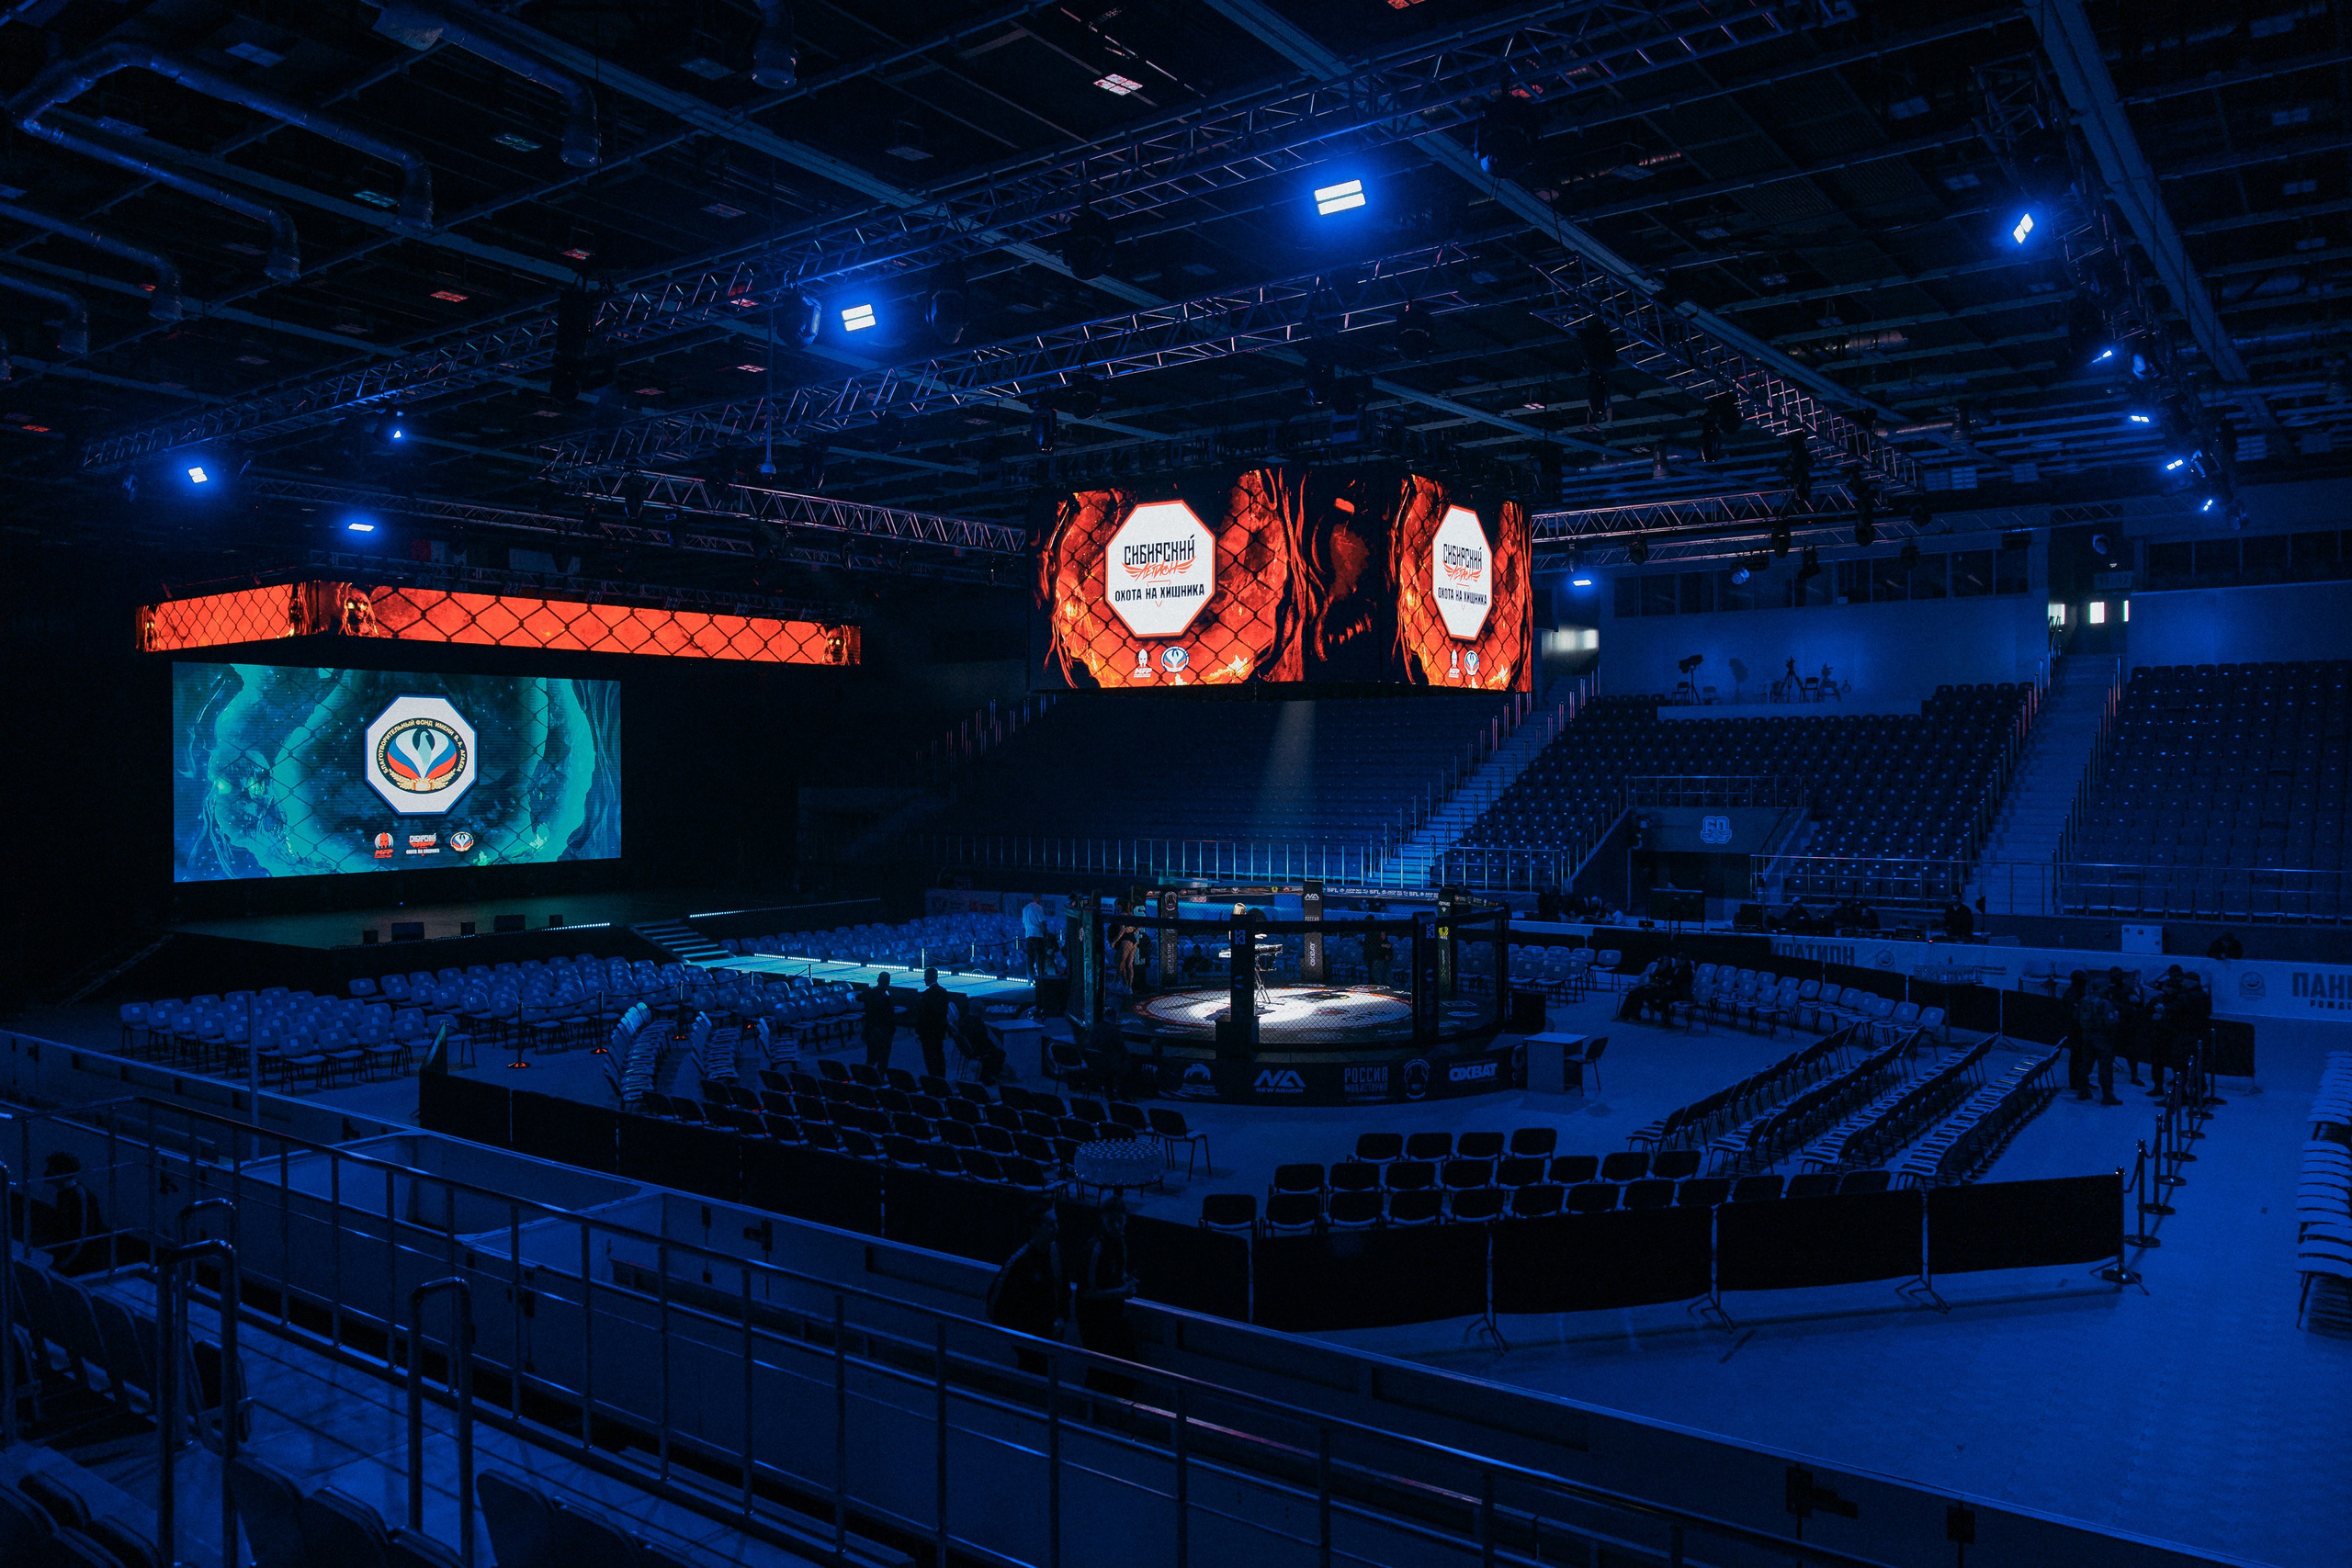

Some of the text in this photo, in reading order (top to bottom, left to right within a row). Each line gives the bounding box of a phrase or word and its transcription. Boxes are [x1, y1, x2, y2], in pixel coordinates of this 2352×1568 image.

[1124, 534, 1194, 565] СИБИРСКИЙ
[1114, 589, 1142, 602] ОХОТА
[1146, 587, 1158, 600] НА
[1438, 587, 1453, 600] ОХОТА
[1455, 590, 1463, 602] НА
[378, 718, 415, 773] БЛАГОТВОРИТЕЛЬНЫЙ
[415, 719, 434, 728] ФОНД
[435, 721, 455, 736] ИМЕНИ
[456, 749, 466, 773] АГАЕВА
[1344, 1066, 1388, 1083] РОССИЯ
